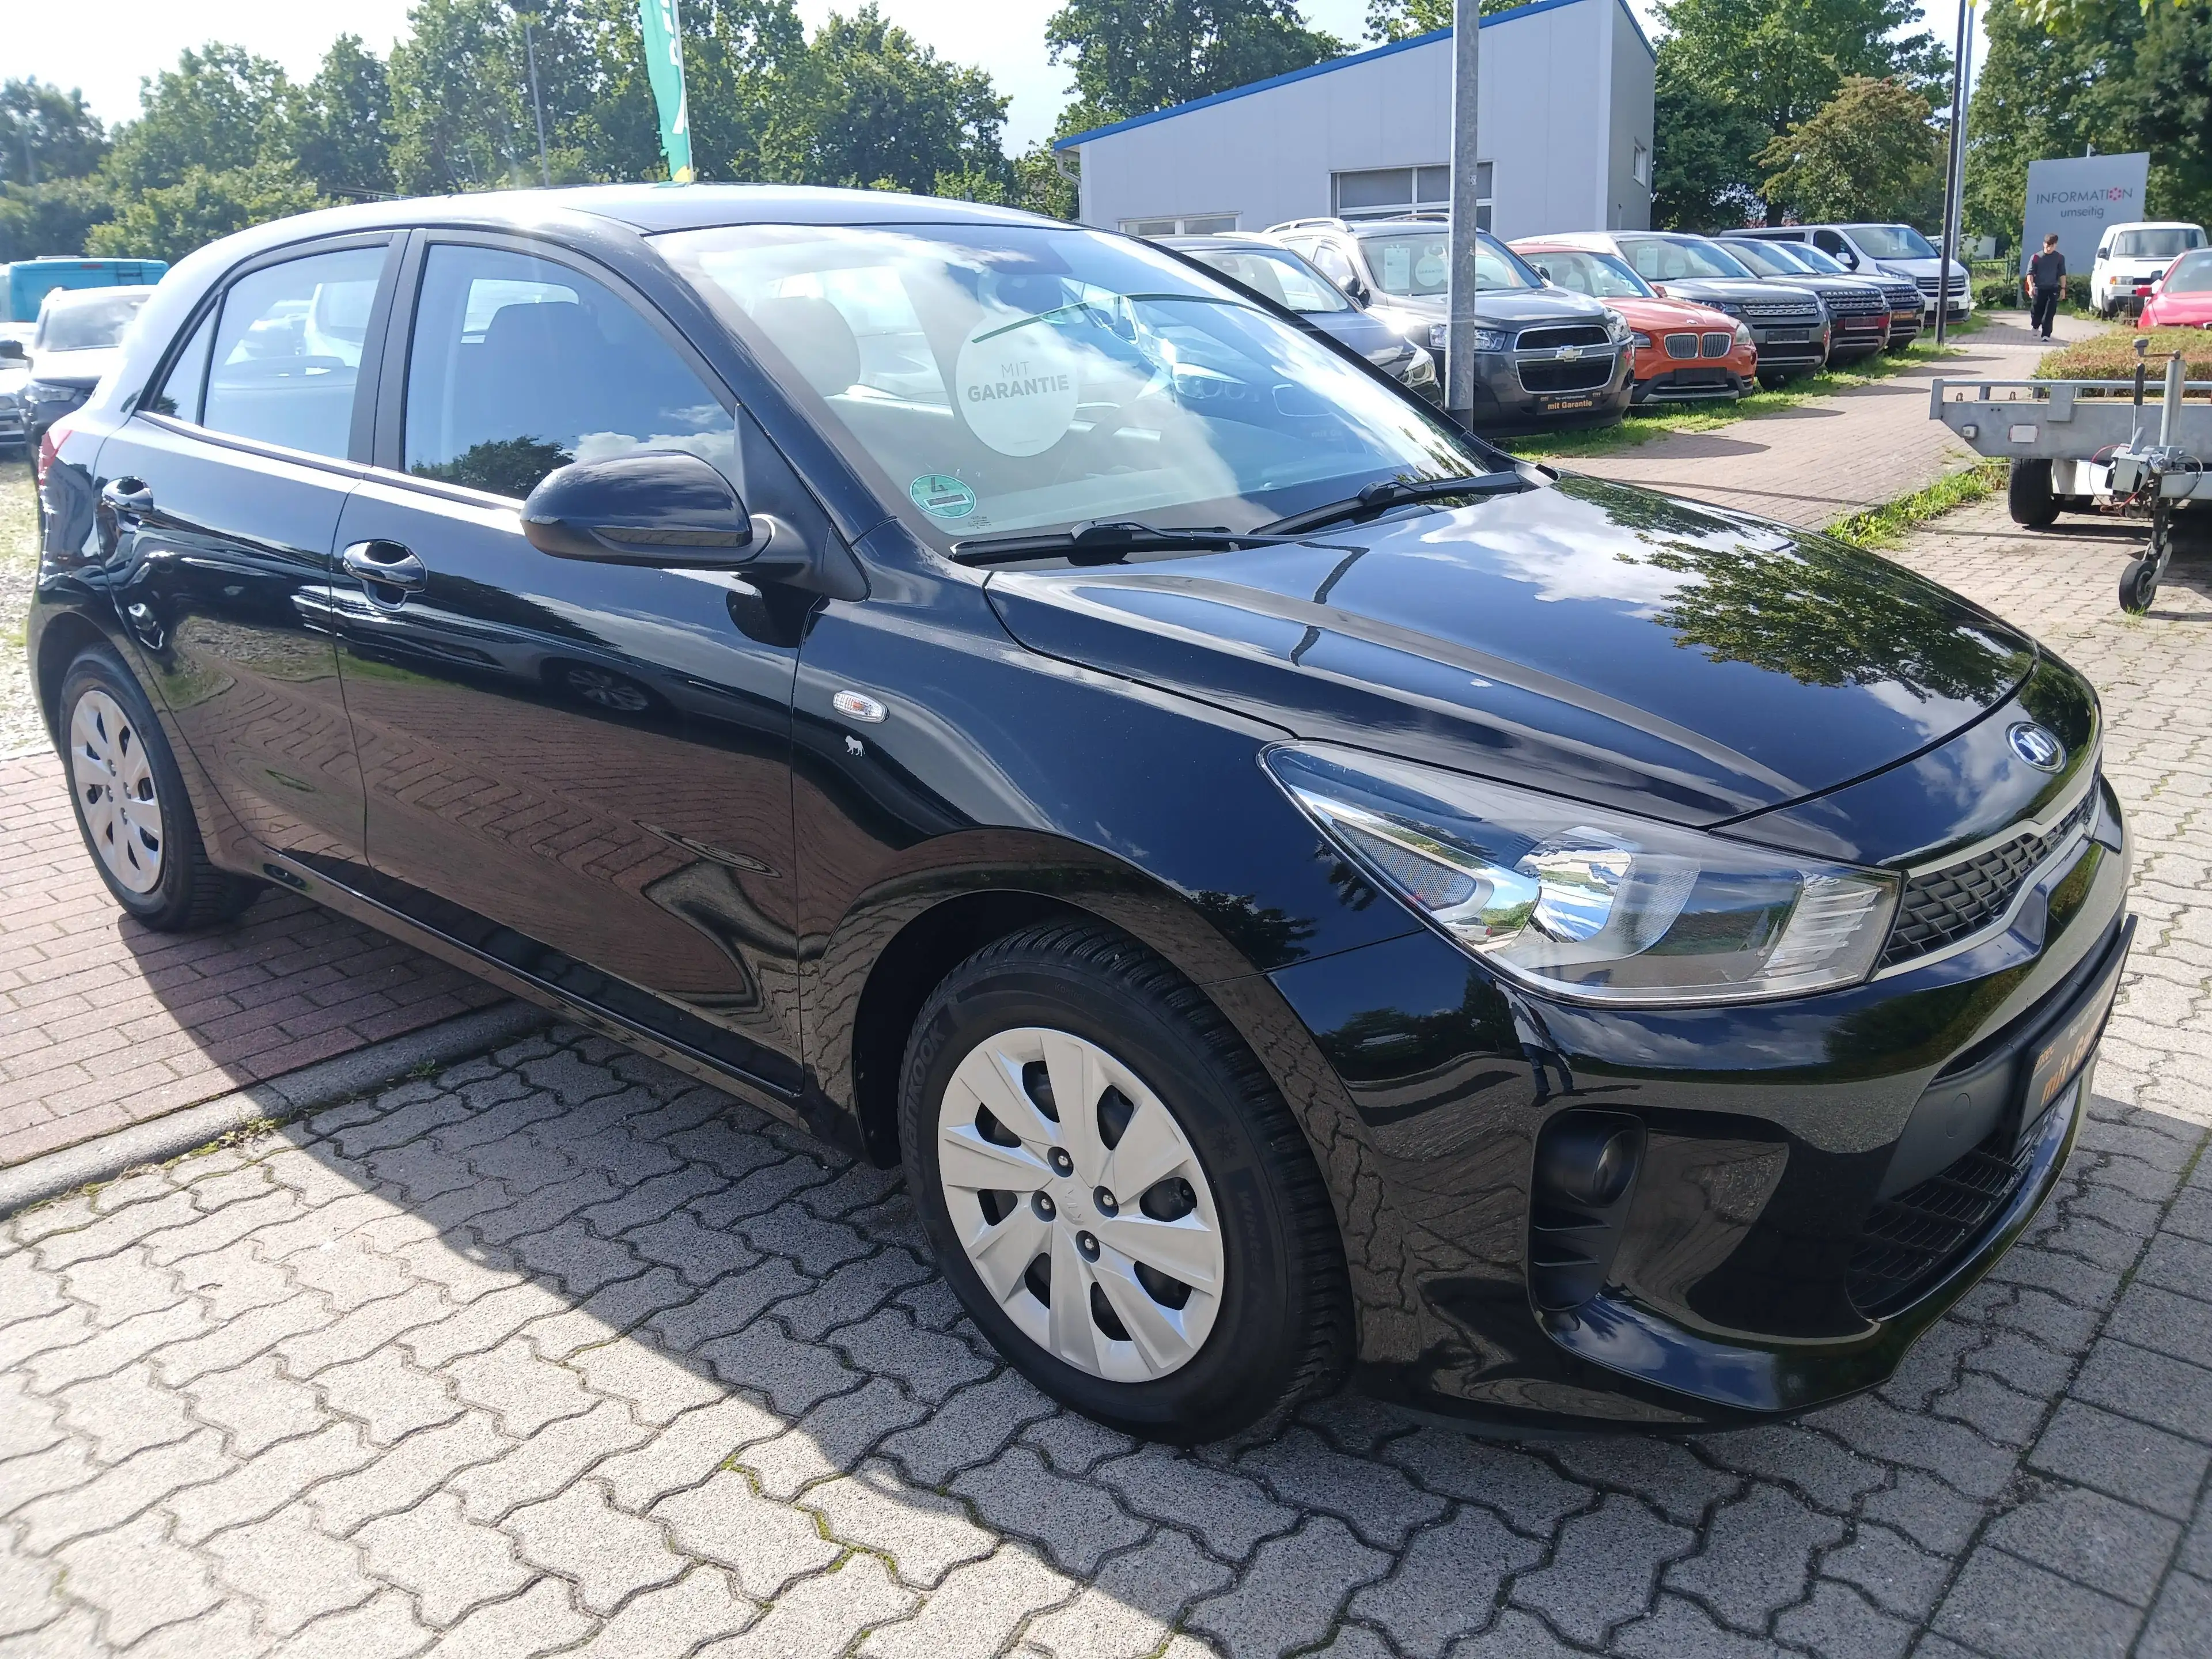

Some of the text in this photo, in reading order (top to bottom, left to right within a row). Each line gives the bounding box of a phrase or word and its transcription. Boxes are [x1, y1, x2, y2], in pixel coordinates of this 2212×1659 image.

[2036, 187, 2133, 204] INFORMATION
[2060, 206, 2104, 219] umseitig
[1001, 361, 1030, 378] MIT
[968, 374, 1069, 402] GARANTIE
[1547, 399, 1593, 410] mit Garantie
[930, 477, 948, 493] 4
[2040, 1053, 2070, 1107] mit
